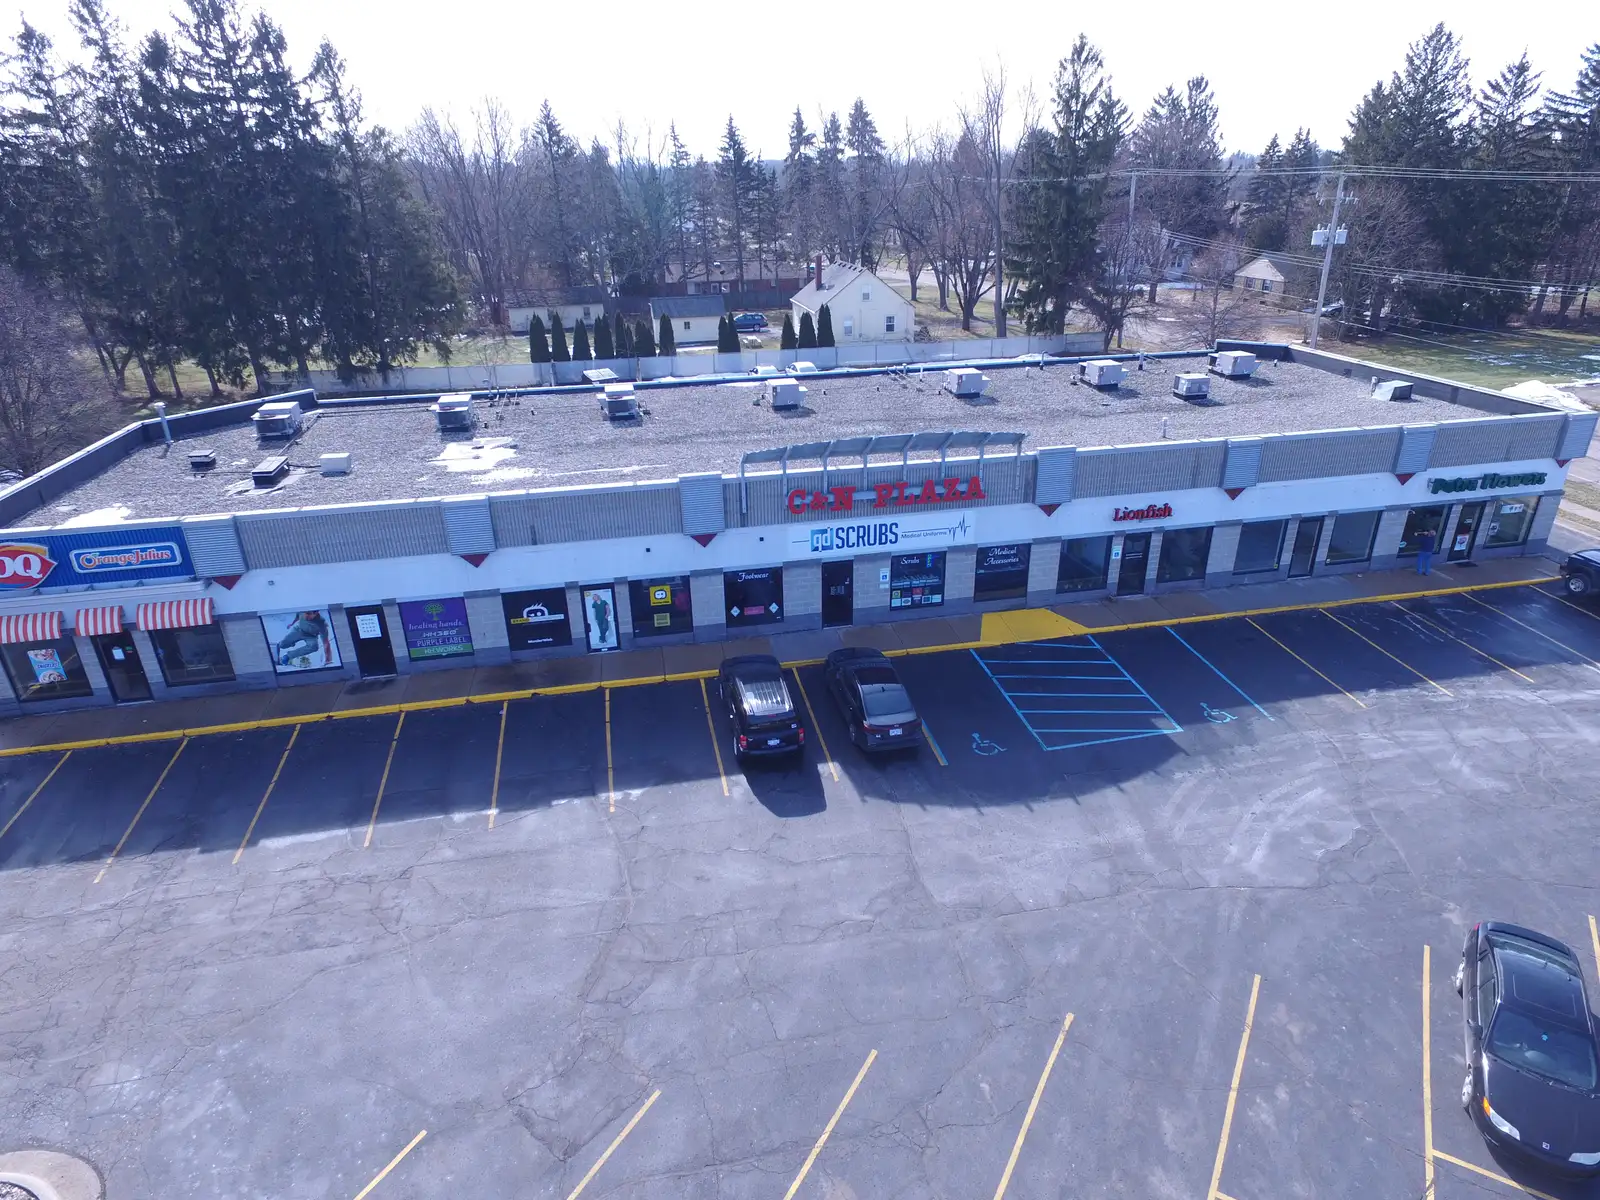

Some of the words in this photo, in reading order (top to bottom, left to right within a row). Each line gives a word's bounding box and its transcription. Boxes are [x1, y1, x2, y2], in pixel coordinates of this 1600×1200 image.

[1480, 473, 1547, 489] Flowers
[788, 486, 856, 515] C&N
[873, 476, 986, 508] PLAZA
[1113, 503, 1173, 522] Lionfish
[835, 522, 899, 549] SCRUBS
[923, 530, 948, 538] Uniforms
[989, 546, 1017, 556] Medical
[900, 556, 920, 565] Scrubs
[984, 556, 1019, 566] Accessories
[0, 553, 43, 579] DQ
[737, 572, 769, 582] Footwear
[409, 622, 438, 630] healing
[417, 639, 444, 647] PURPLE
[445, 636, 467, 645] LABEL
